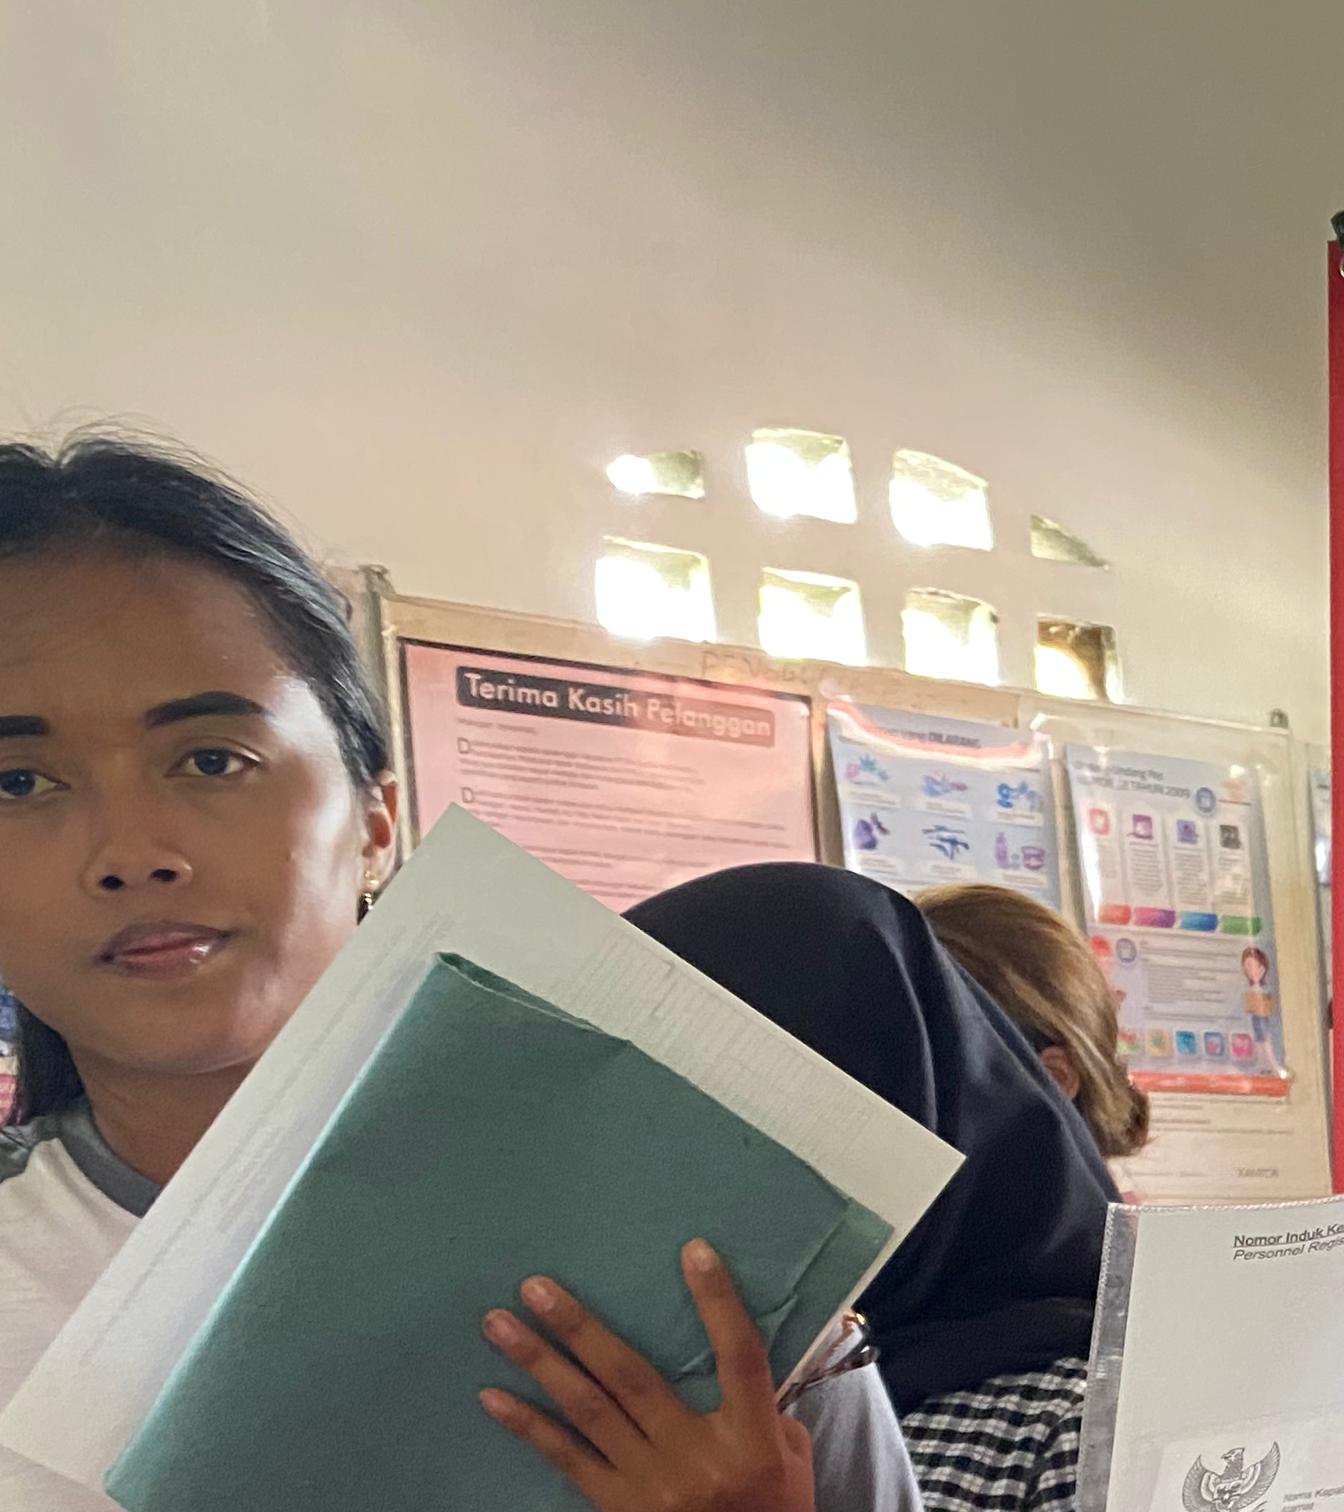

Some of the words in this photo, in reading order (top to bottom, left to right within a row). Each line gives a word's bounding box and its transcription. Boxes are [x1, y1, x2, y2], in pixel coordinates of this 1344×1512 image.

[463, 671, 559, 709] Terima
[568, 687, 638, 718] Kasih
[646, 700, 771, 740] Pelanggan
[1233, 1233, 1284, 1250] Nomor
[1286, 1226, 1325, 1246] Induk
[1232, 1243, 1306, 1261] Personnel
